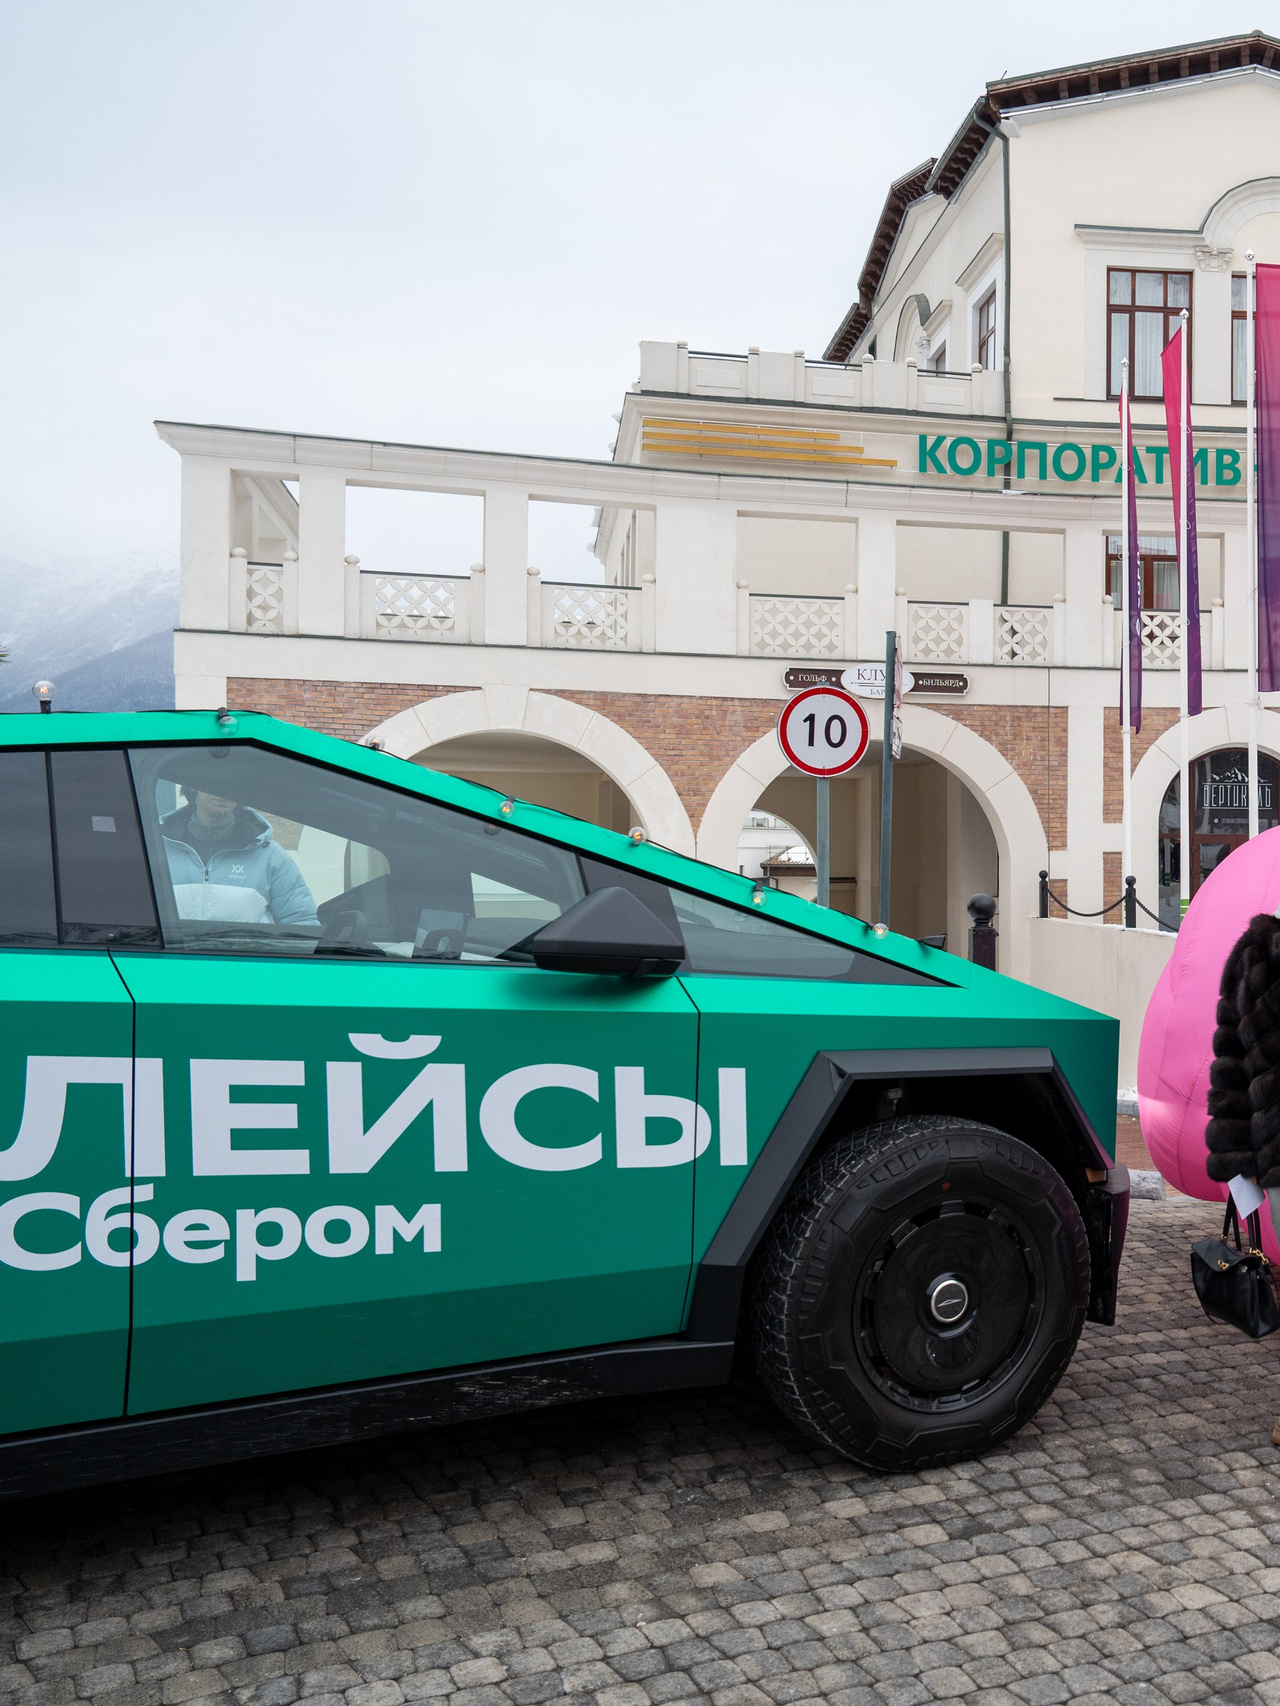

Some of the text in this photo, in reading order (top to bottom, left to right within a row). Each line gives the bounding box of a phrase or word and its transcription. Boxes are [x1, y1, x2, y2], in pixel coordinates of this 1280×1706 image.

[918, 434, 1257, 486] КОРПОРАТИВ
[798, 674, 827, 682] ГОЛЬФ
[857, 668, 886, 681] КЛУ
[923, 678, 960, 688] БИЛЬЯРД
[802, 713, 848, 749] 10
[1203, 784, 1271, 808] ВЕРТИКЛЬ
[0, 1033, 748, 1182] ЛЕЙСЫ
[0, 1183, 442, 1282] Сбером
